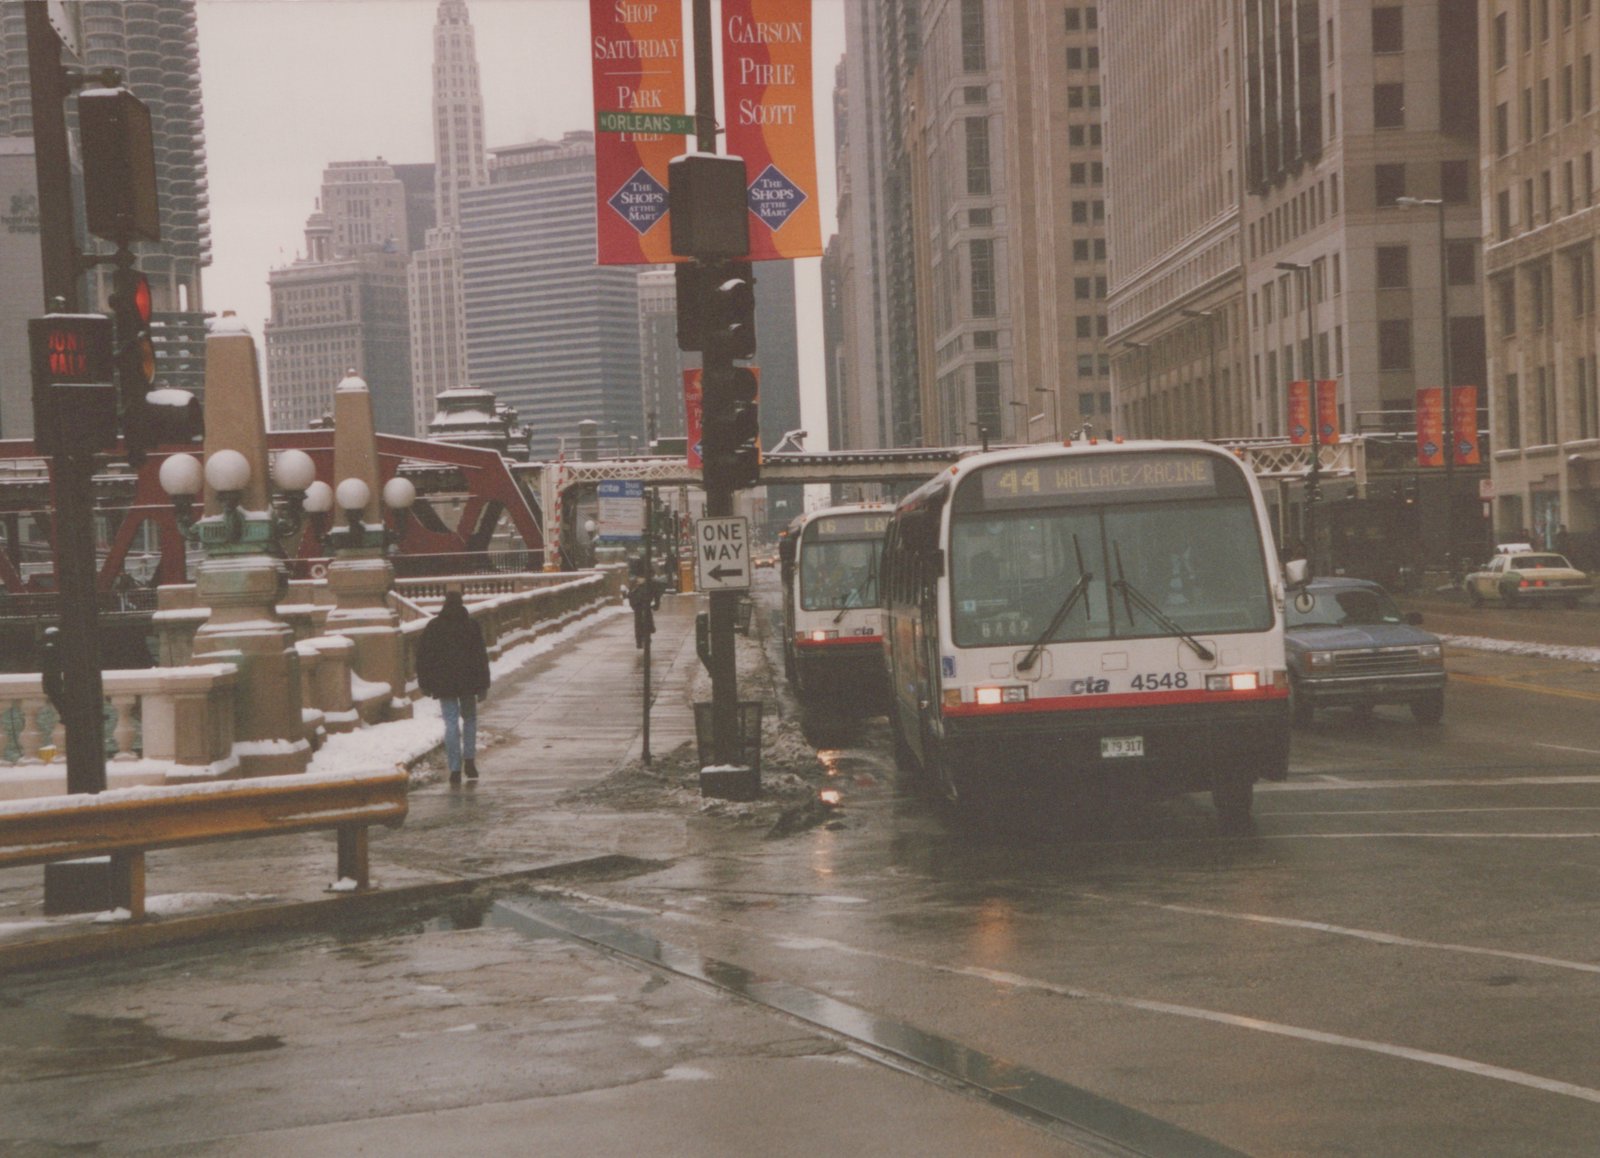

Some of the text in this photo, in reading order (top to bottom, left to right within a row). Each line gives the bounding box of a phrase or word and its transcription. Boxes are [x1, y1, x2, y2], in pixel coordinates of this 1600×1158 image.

[614, 0, 657, 23] SHOP
[728, 15, 803, 43] CARSON
[594, 36, 679, 59] SATURDAY
[739, 57, 796, 85] PIRIE
[617, 86, 662, 109] PARK
[739, 98, 796, 125] SCOTT
[607, 114, 671, 131] ORLEANS
[676, 119, 686, 129] ST
[630, 182, 652, 192] THE
[761, 178, 782, 189] THE
[620, 191, 664, 204] SHOPS
[751, 187, 794, 201] SHOPS
[629, 212, 656, 221] MART
[760, 208, 786, 217] MART
[998, 460, 1206, 494] 44 WALLACE/RACINE
[703, 523, 742, 541] ONE
[703, 543, 743, 561] WAY
[1070, 671, 1189, 694] cta 4548
